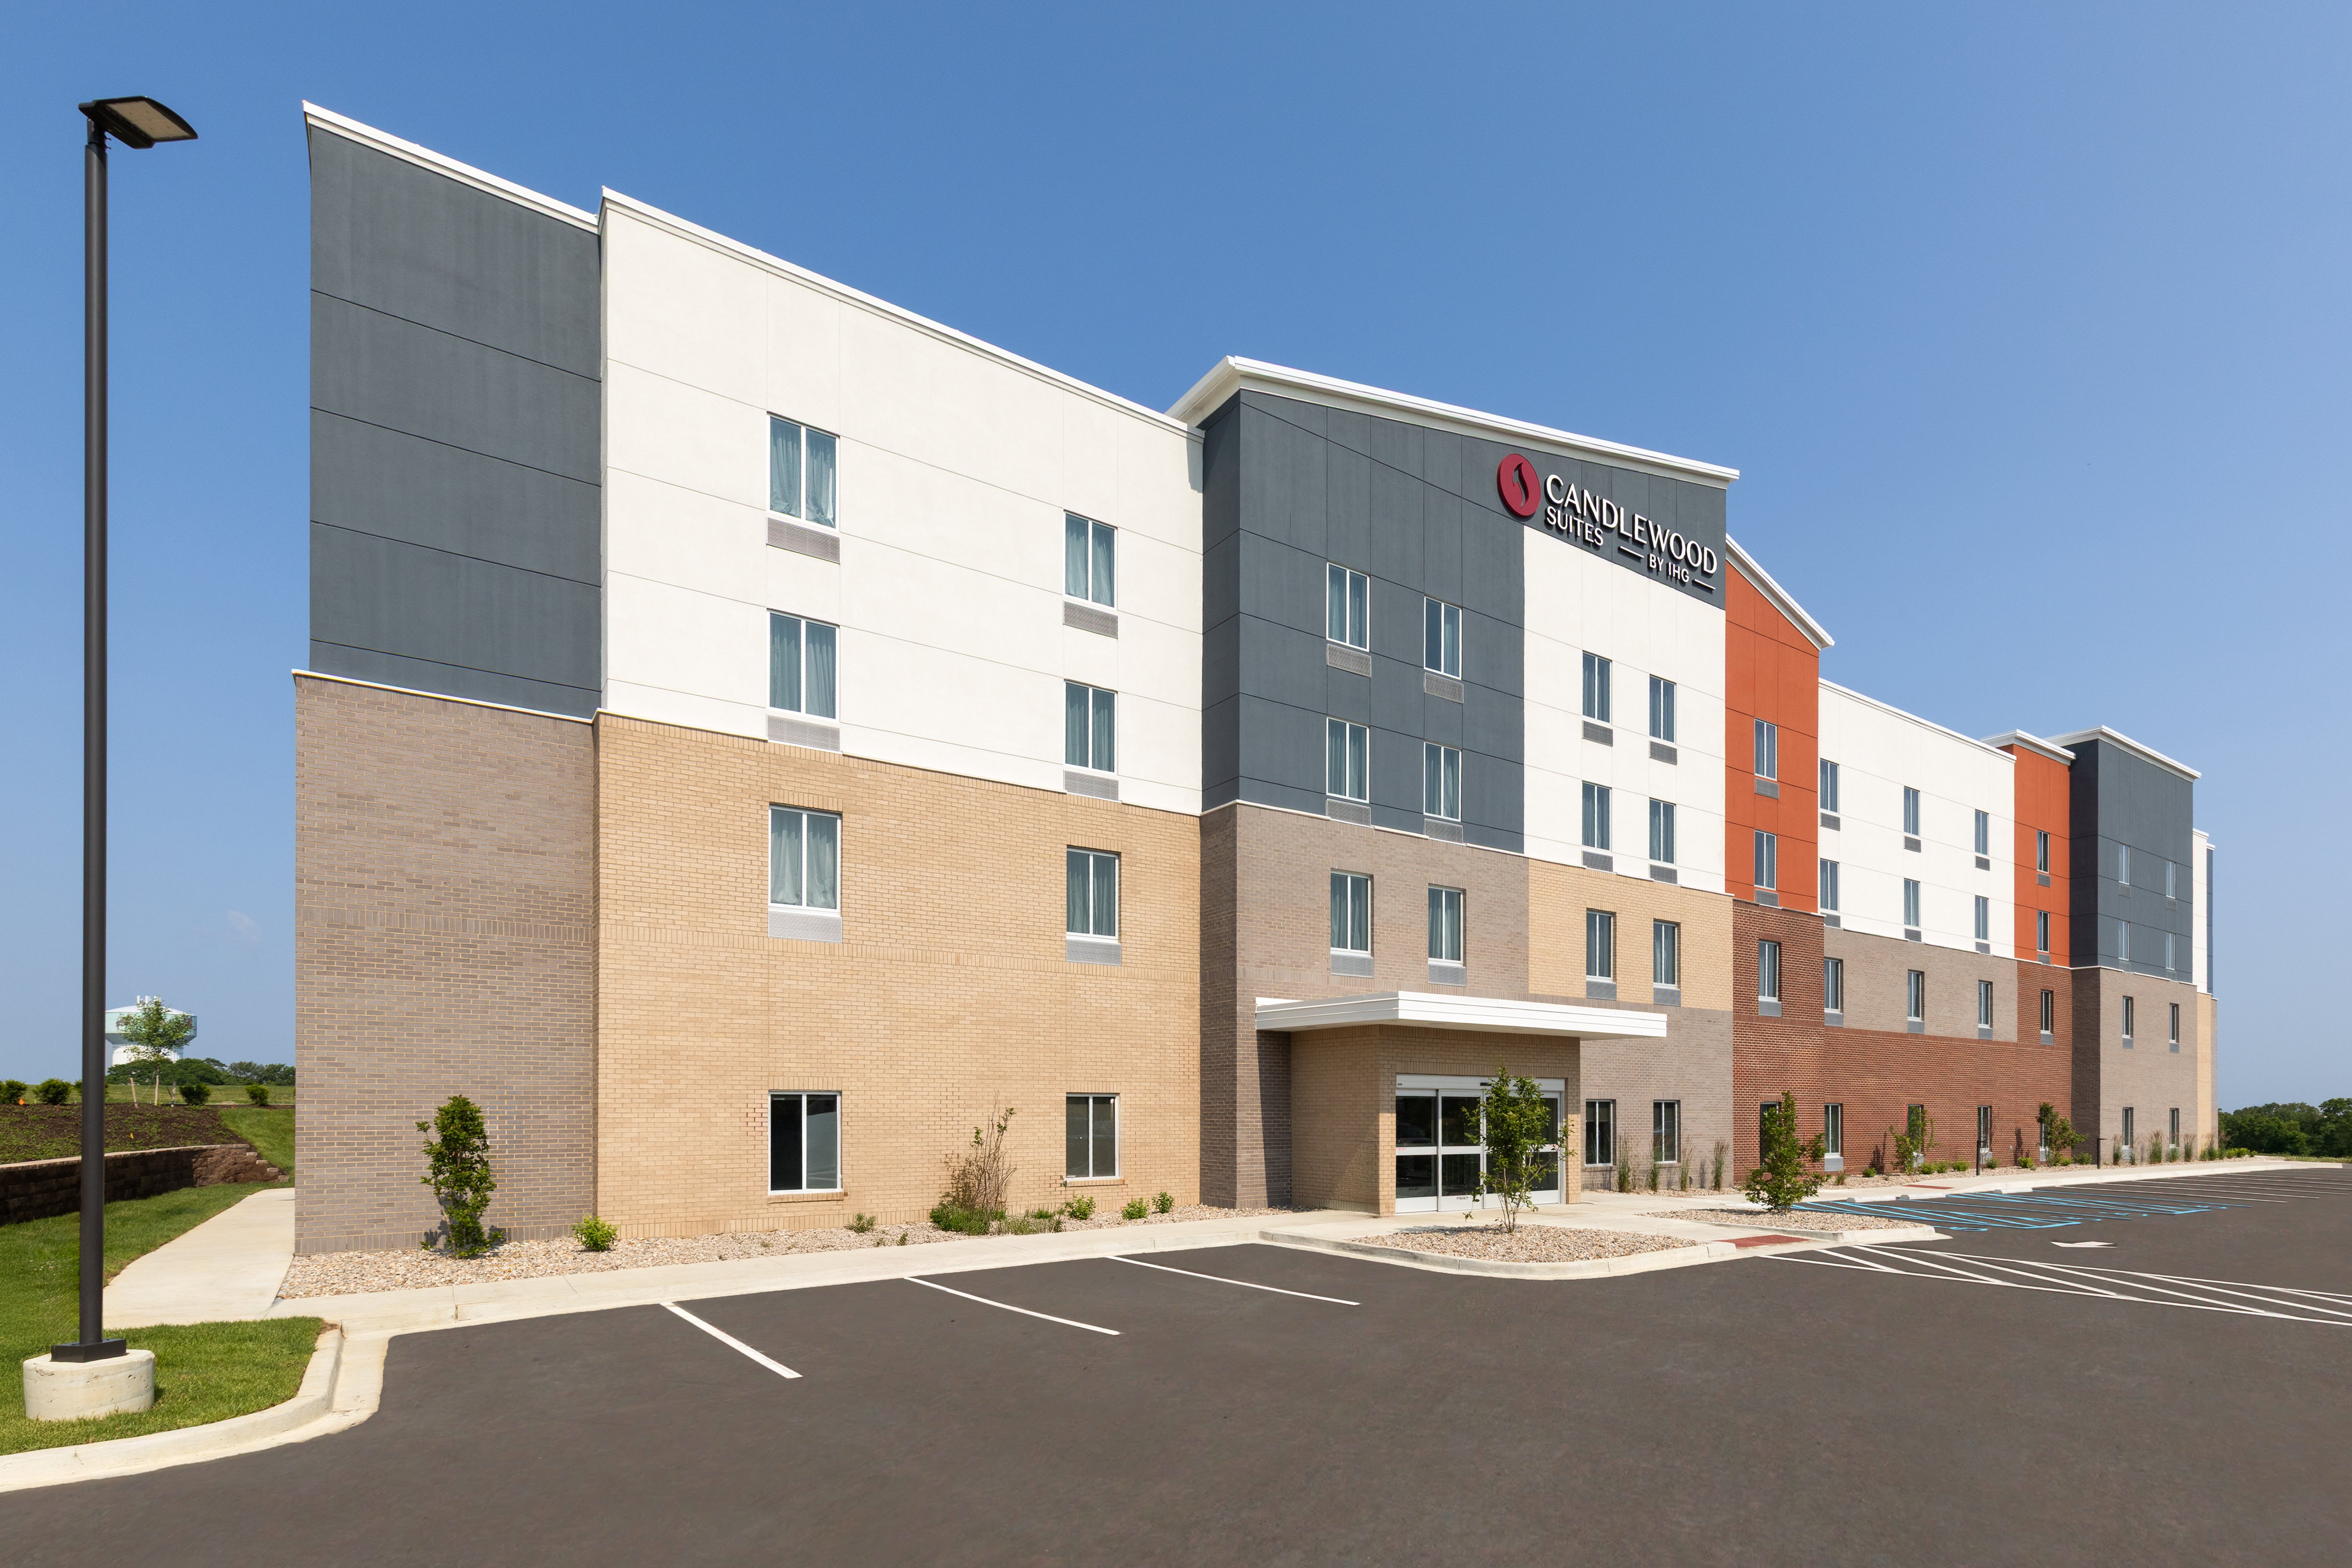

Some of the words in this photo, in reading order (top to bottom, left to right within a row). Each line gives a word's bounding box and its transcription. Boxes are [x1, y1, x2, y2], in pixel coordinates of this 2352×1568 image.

[1546, 474, 1717, 574] CANDLEWOOD
[1546, 506, 1604, 546] SUITES
[1649, 553, 1664, 572] BY
[1668, 561, 1690, 583] IHG
